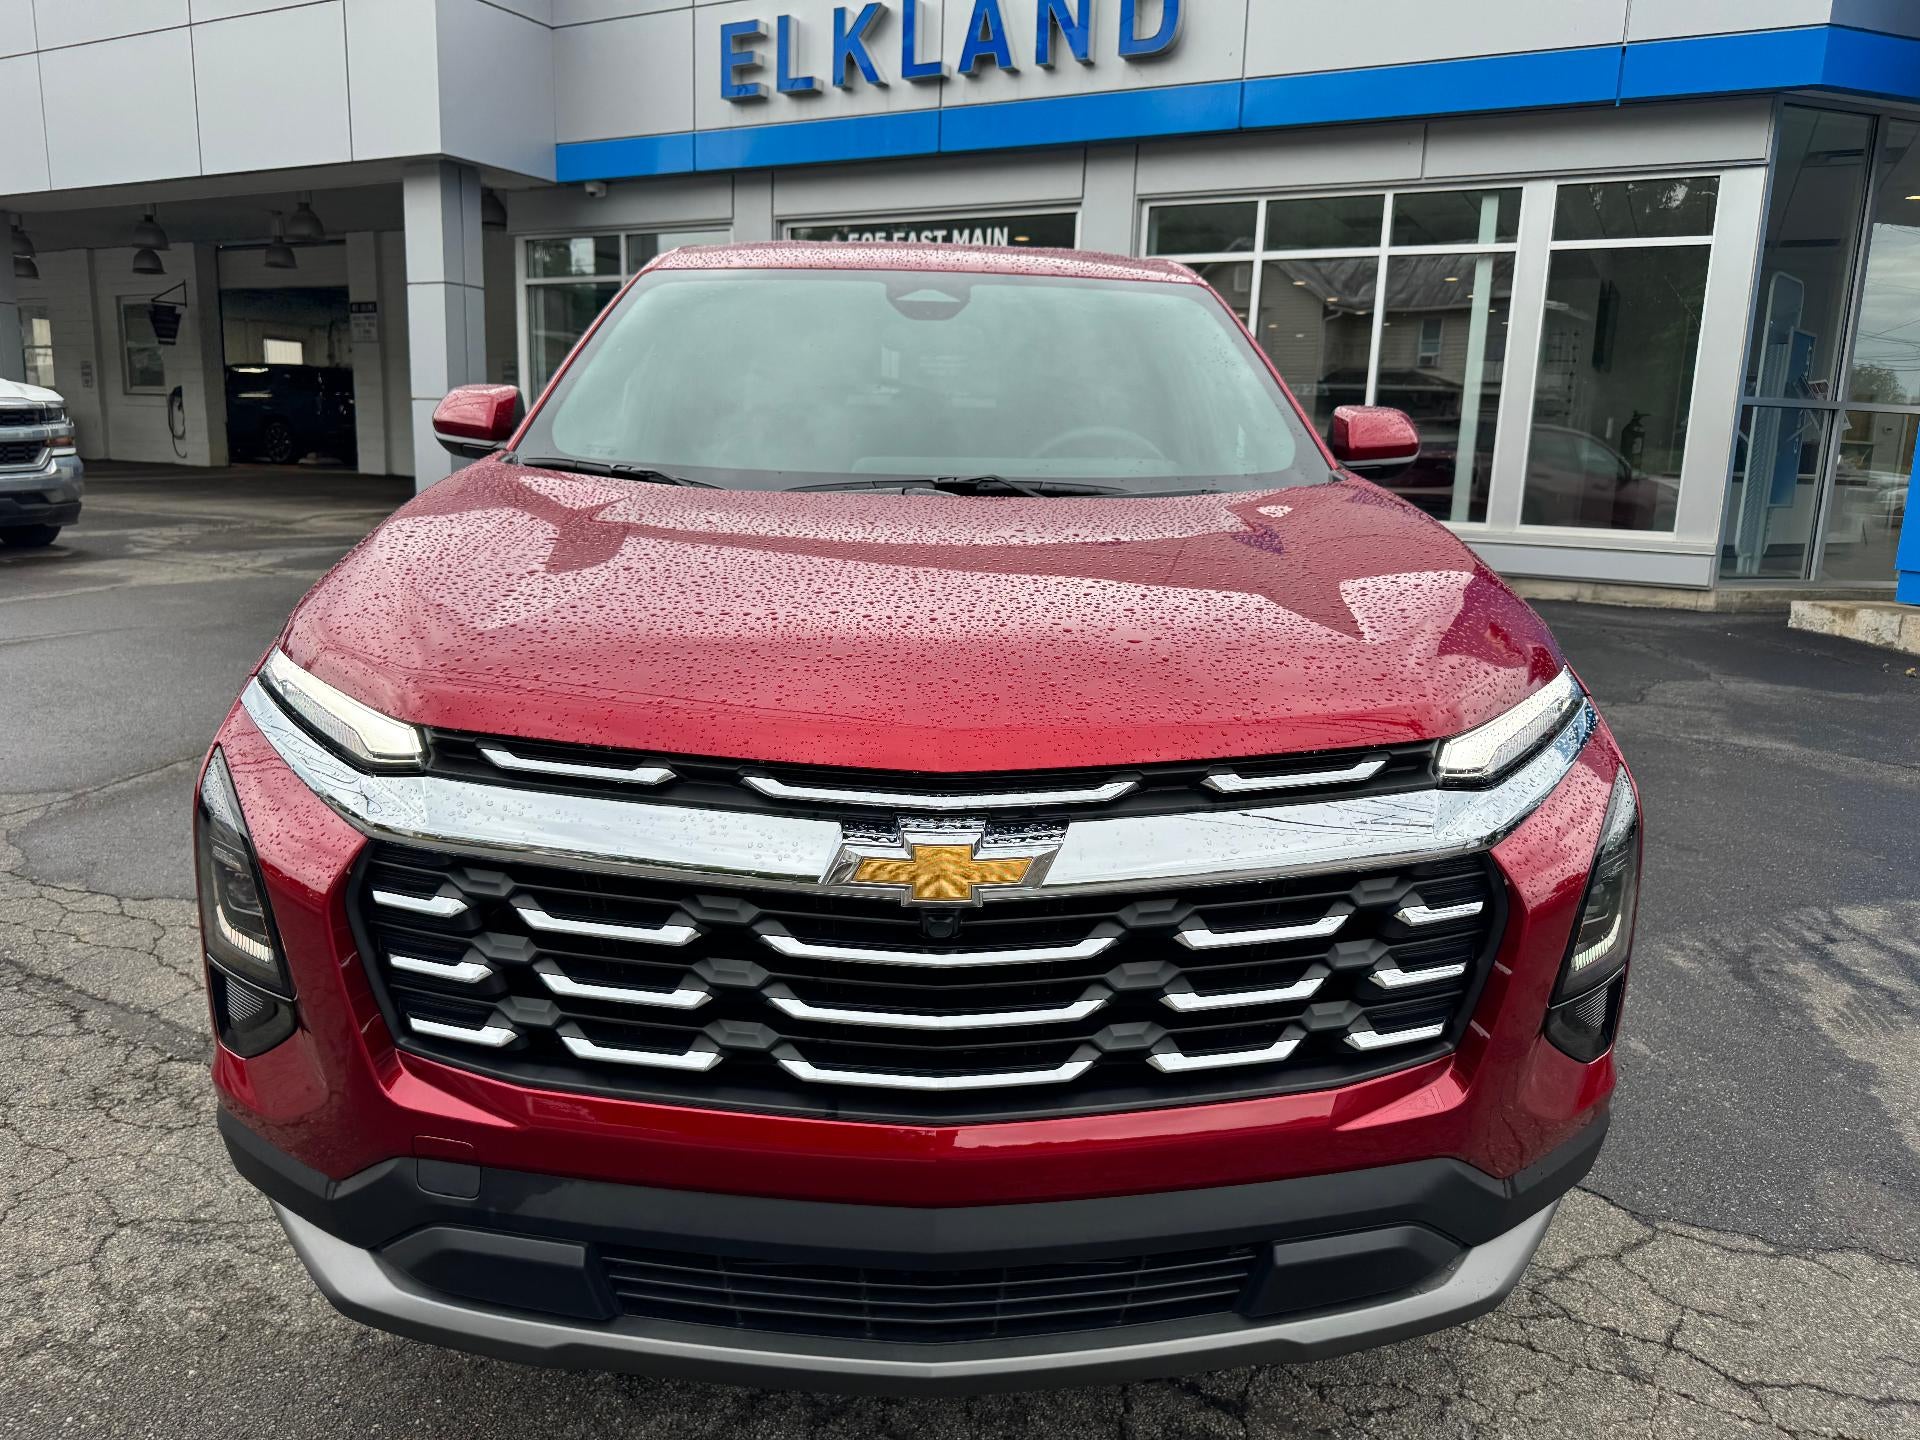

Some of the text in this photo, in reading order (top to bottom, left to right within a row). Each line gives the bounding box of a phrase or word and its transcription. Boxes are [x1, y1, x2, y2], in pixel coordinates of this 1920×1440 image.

[720, 0, 1183, 101] ELKLAND
[892, 229, 948, 244] EAST
[952, 226, 1009, 247] MAIN
